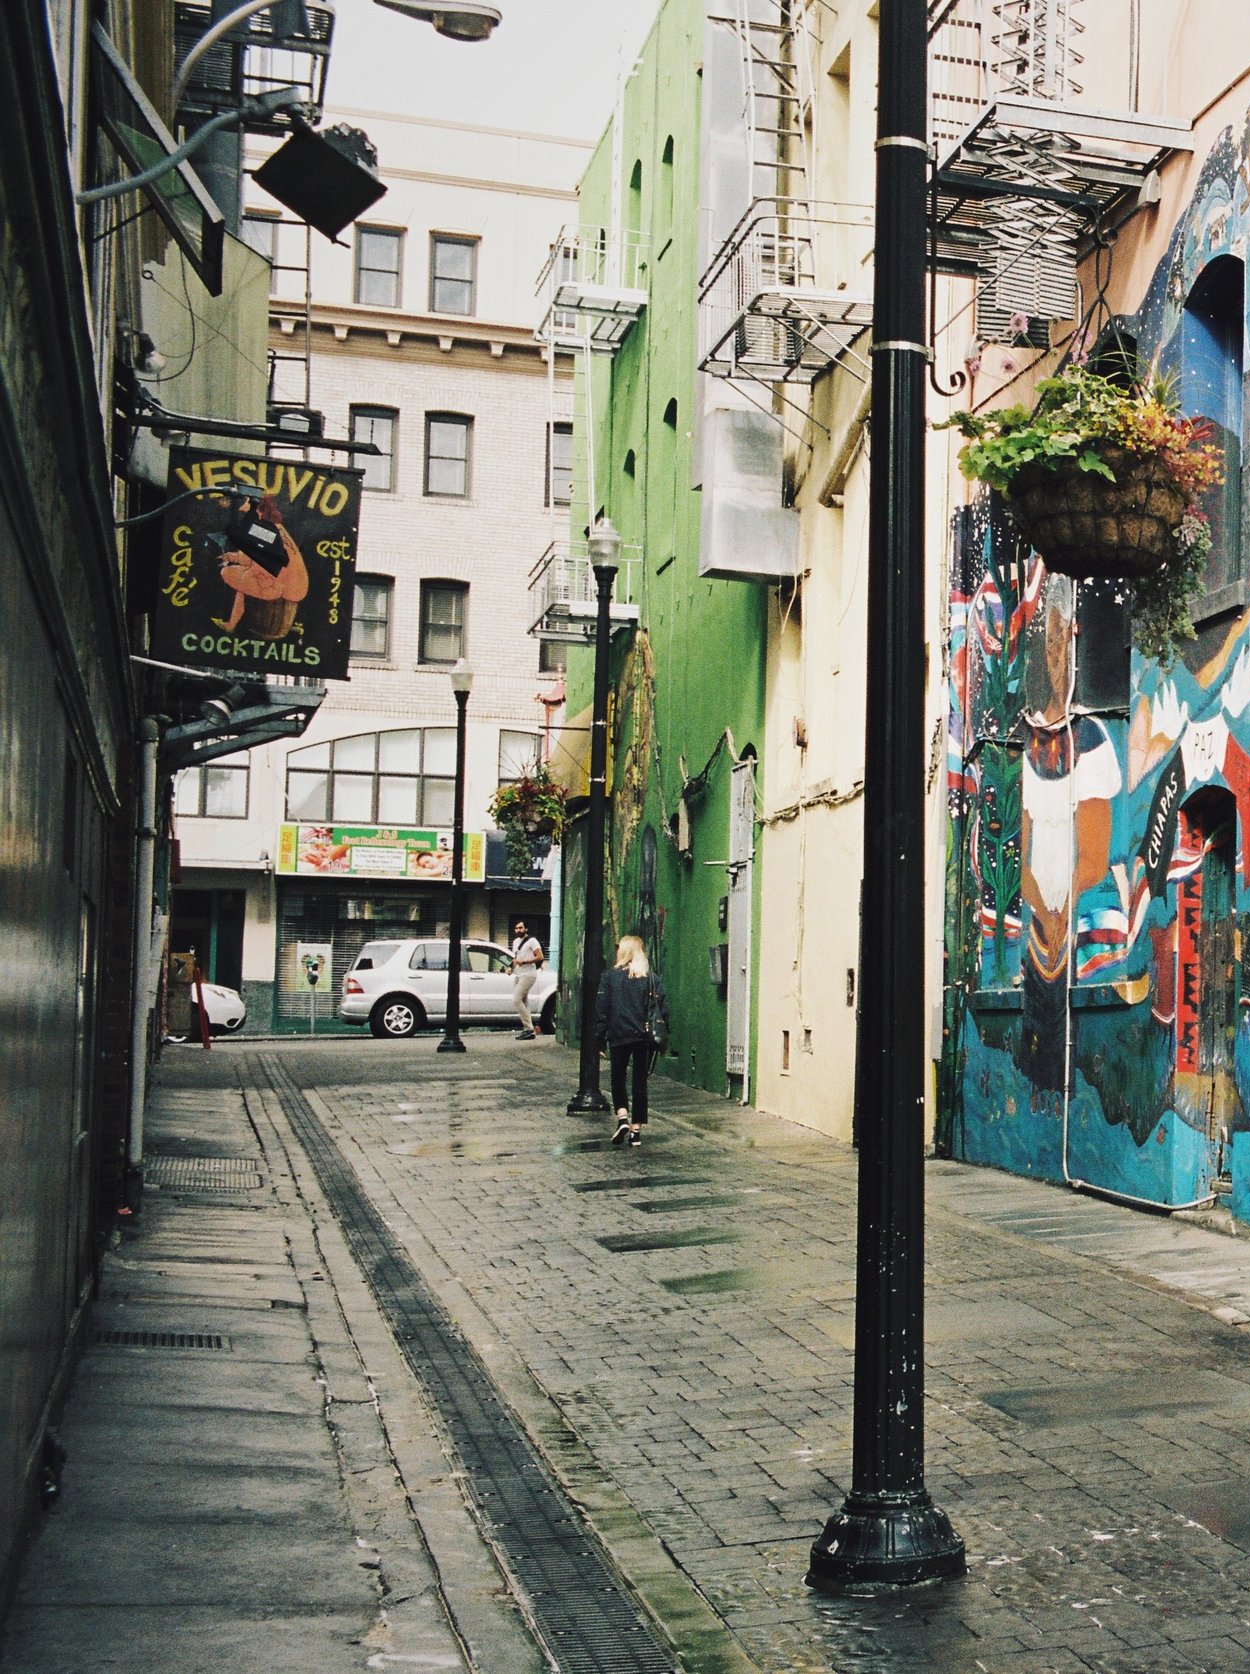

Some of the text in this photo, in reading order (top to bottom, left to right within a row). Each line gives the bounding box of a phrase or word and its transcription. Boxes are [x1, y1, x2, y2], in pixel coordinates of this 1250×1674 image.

[175, 459, 350, 517] VESUVIO
[162, 525, 198, 607] café
[328, 560, 342, 625] 1948
[181, 633, 321, 666] COCKTAILS
[1193, 731, 1214, 761] PAZ
[1147, 771, 1178, 869] CHIAPAS
